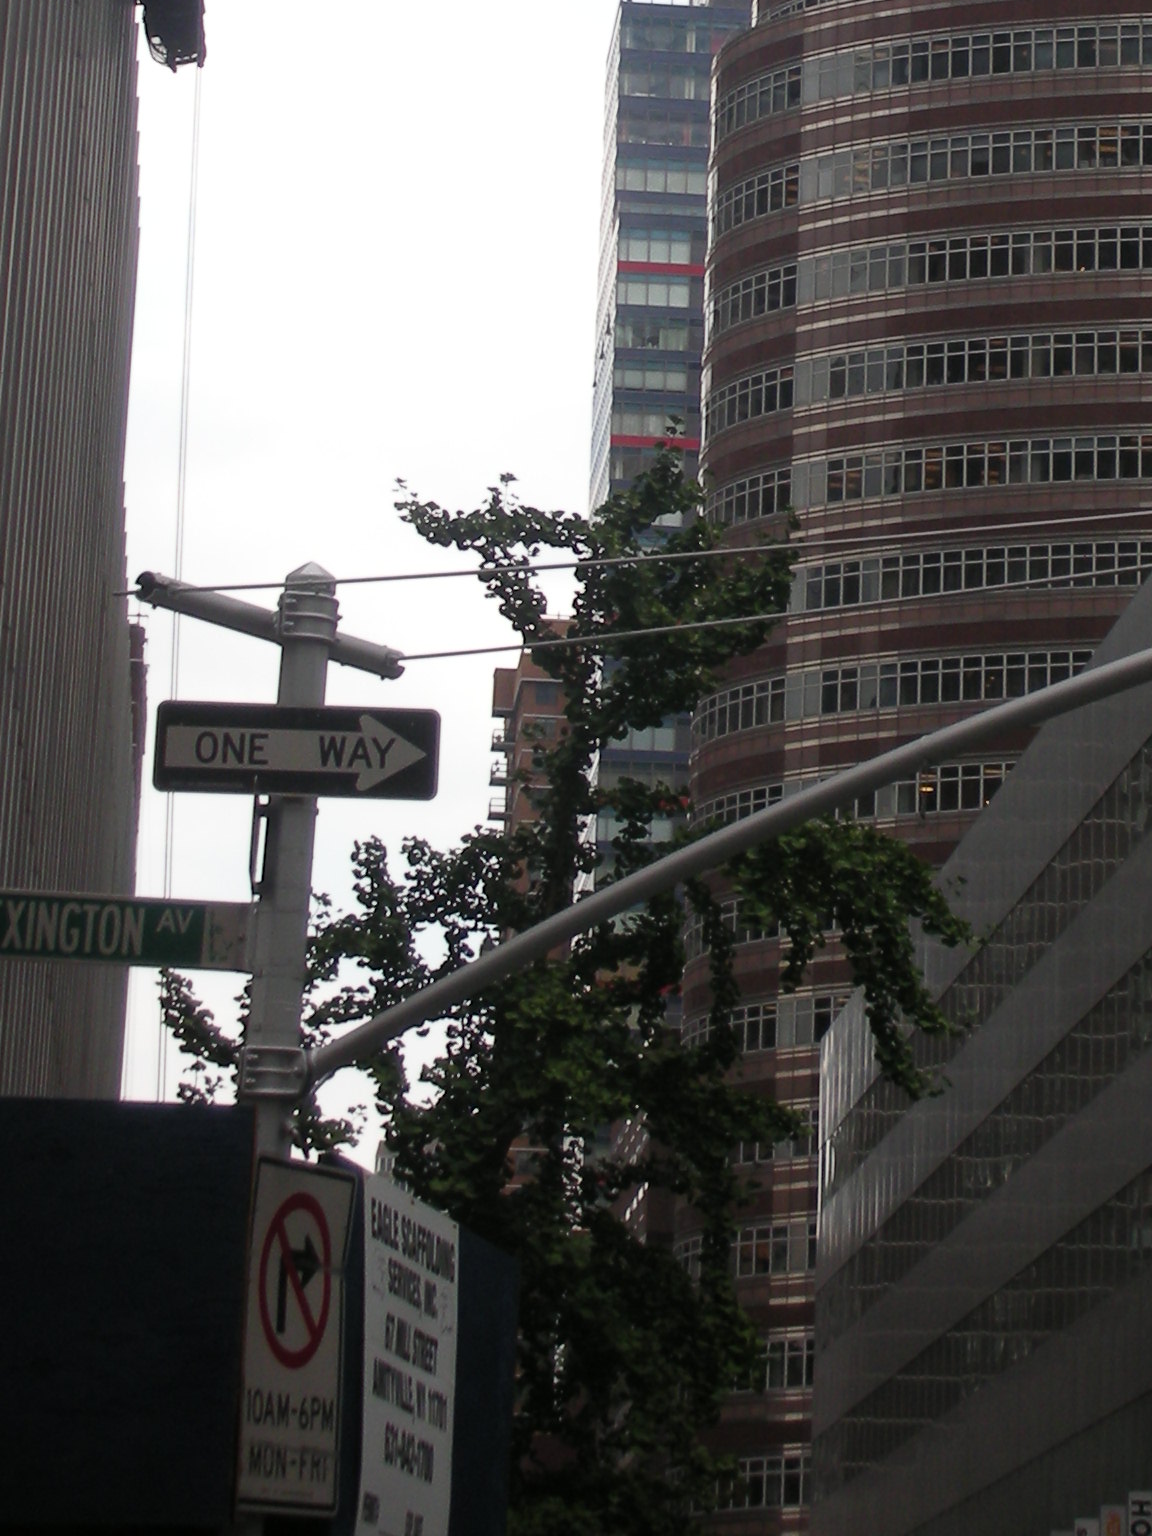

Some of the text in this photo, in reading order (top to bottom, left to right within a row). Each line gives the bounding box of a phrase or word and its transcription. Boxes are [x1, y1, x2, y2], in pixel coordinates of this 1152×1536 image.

[195, 731, 396, 769] ONE WAY
[0, 899, 194, 957] XINGTON AV
[371, 1196, 456, 1283] EAGLE SCAFFOLDING
[413, 1326, 438, 1376] STREET
[247, 1387, 335, 1432] 10AM-6PM
[249, 1444, 328, 1483] MON-FRI
